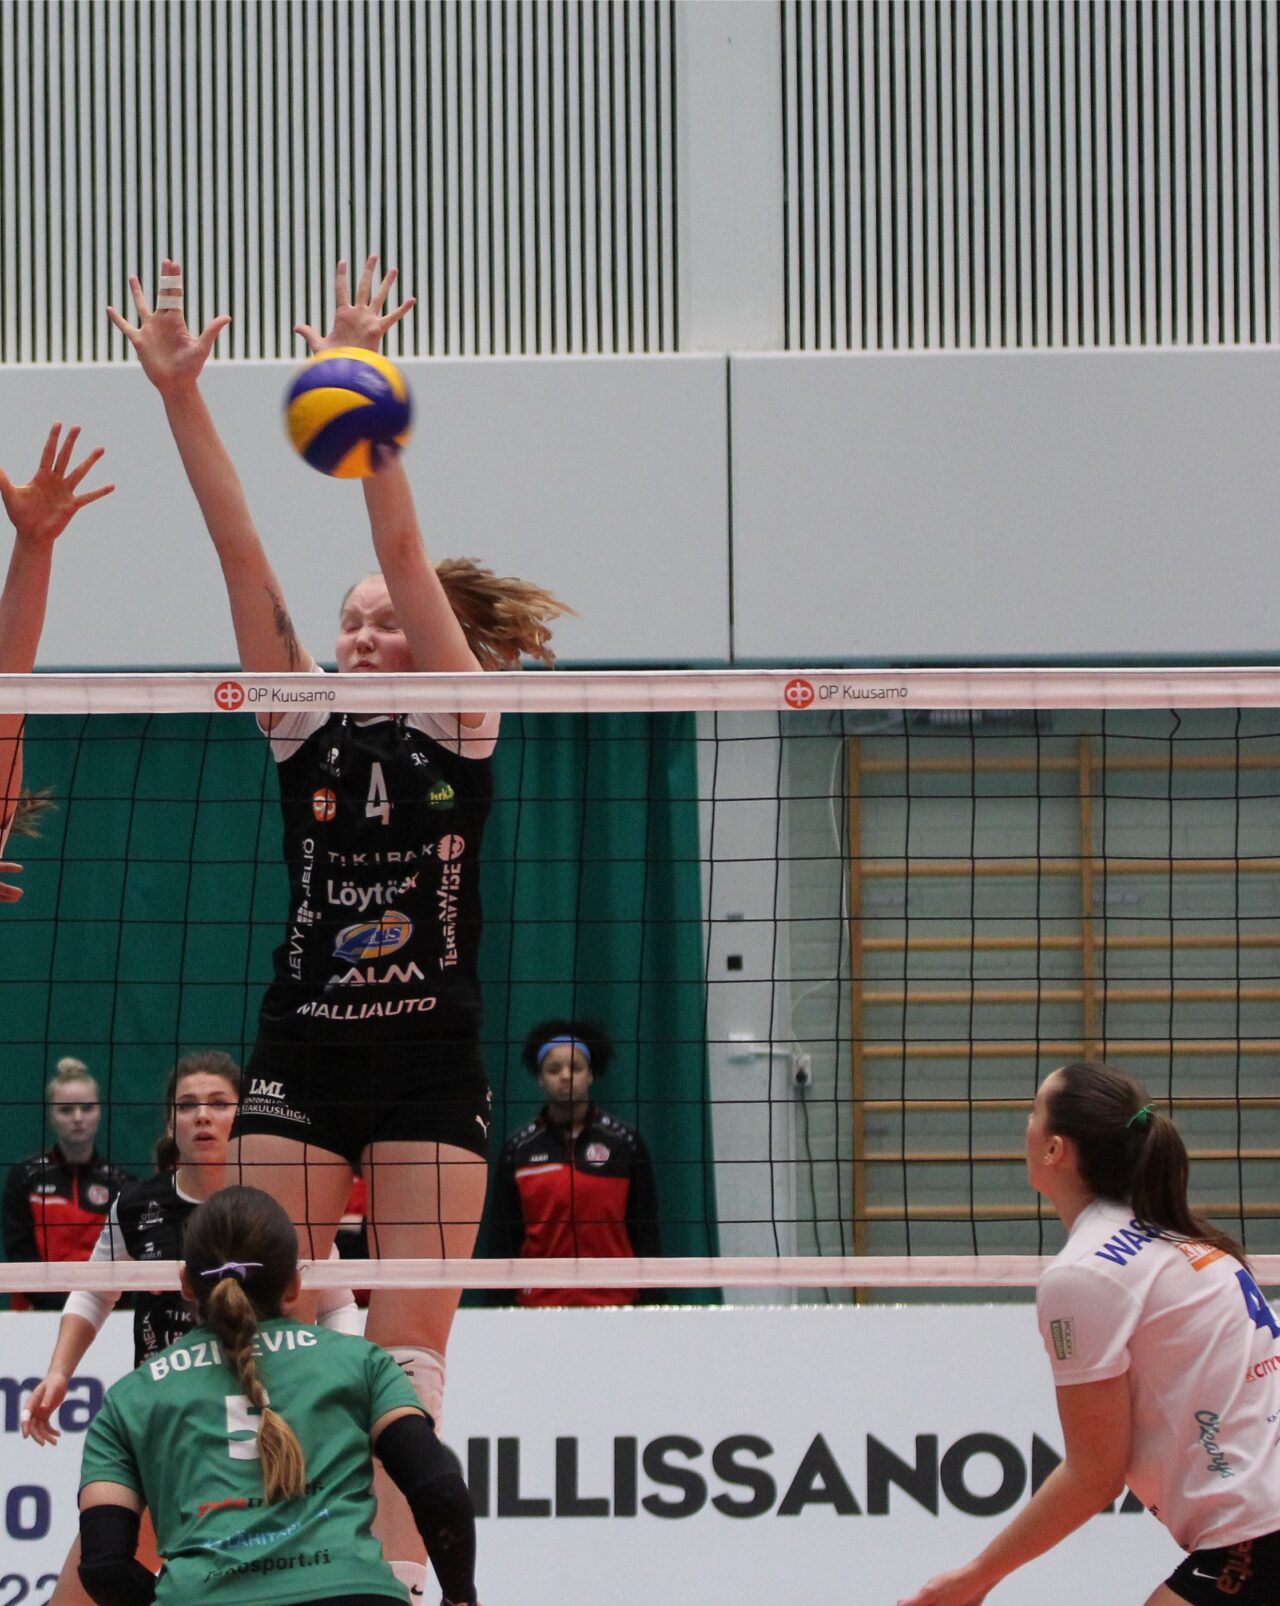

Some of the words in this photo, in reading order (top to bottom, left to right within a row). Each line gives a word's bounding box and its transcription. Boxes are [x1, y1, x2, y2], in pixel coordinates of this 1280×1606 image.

[247, 687, 268, 702] OP
[271, 688, 336, 703] Kuusamo
[819, 685, 839, 700] OP
[843, 685, 908, 700] Kuusamo
[365, 762, 391, 825] 4
[289, 926, 306, 981] LEVY
[297, 997, 437, 1020] MALLIAUTO
[225, 1394, 271, 1460] 5
